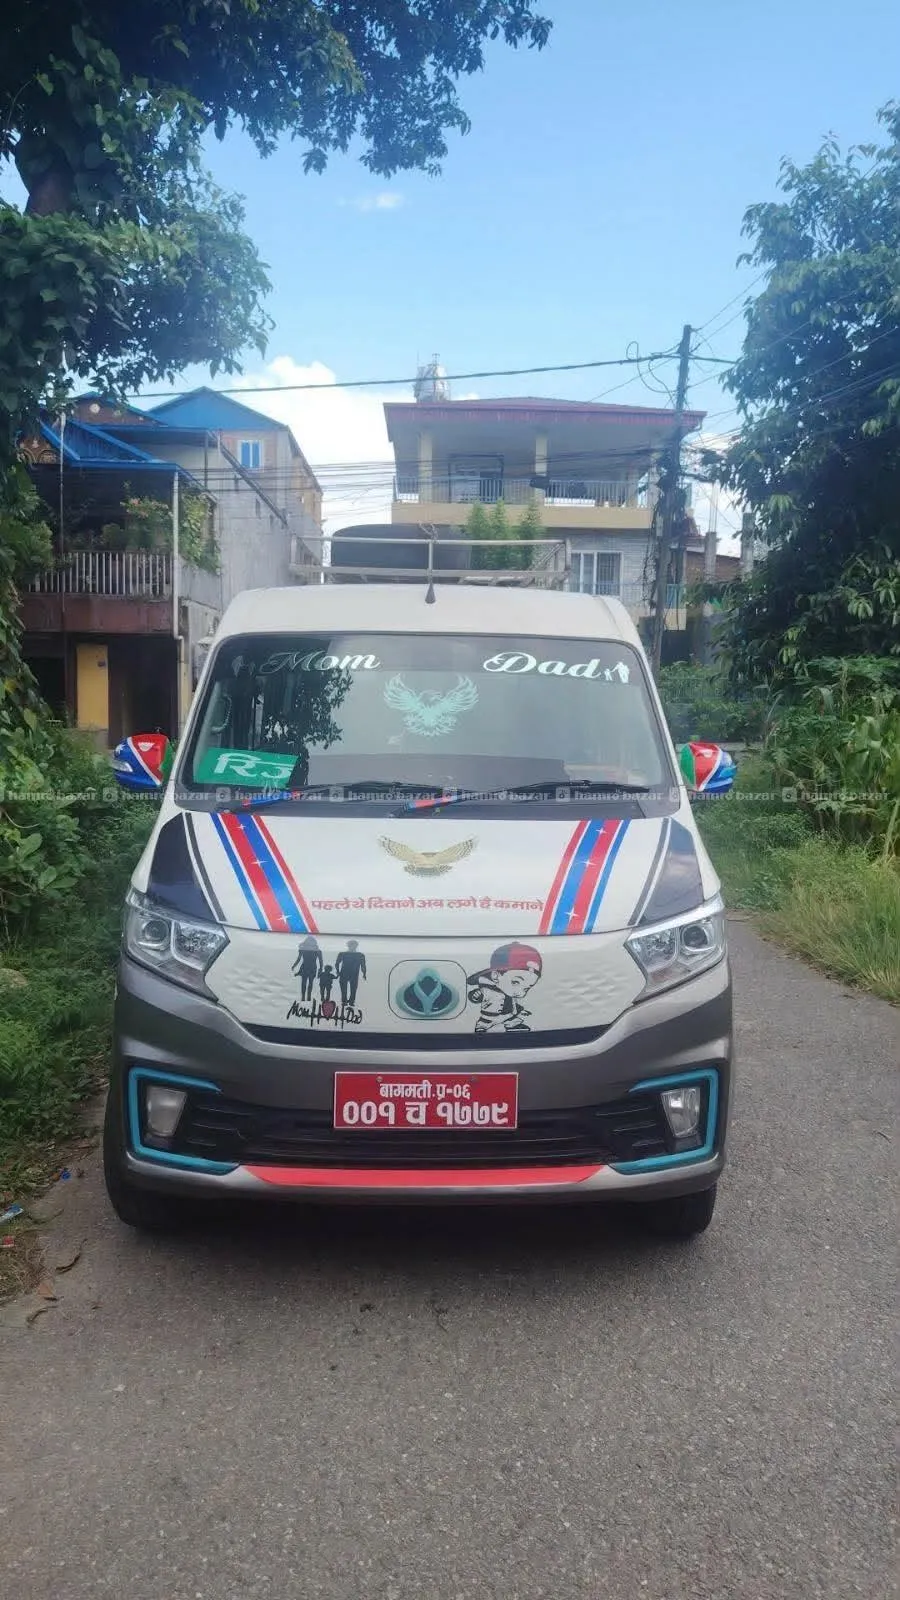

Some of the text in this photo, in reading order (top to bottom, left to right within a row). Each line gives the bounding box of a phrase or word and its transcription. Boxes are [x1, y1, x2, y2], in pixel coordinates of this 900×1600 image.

[260, 650, 381, 674] Mom
[483, 651, 601, 679] Dad
[342, 1101, 396, 1125] ००१
[405, 1101, 428, 1125] च
